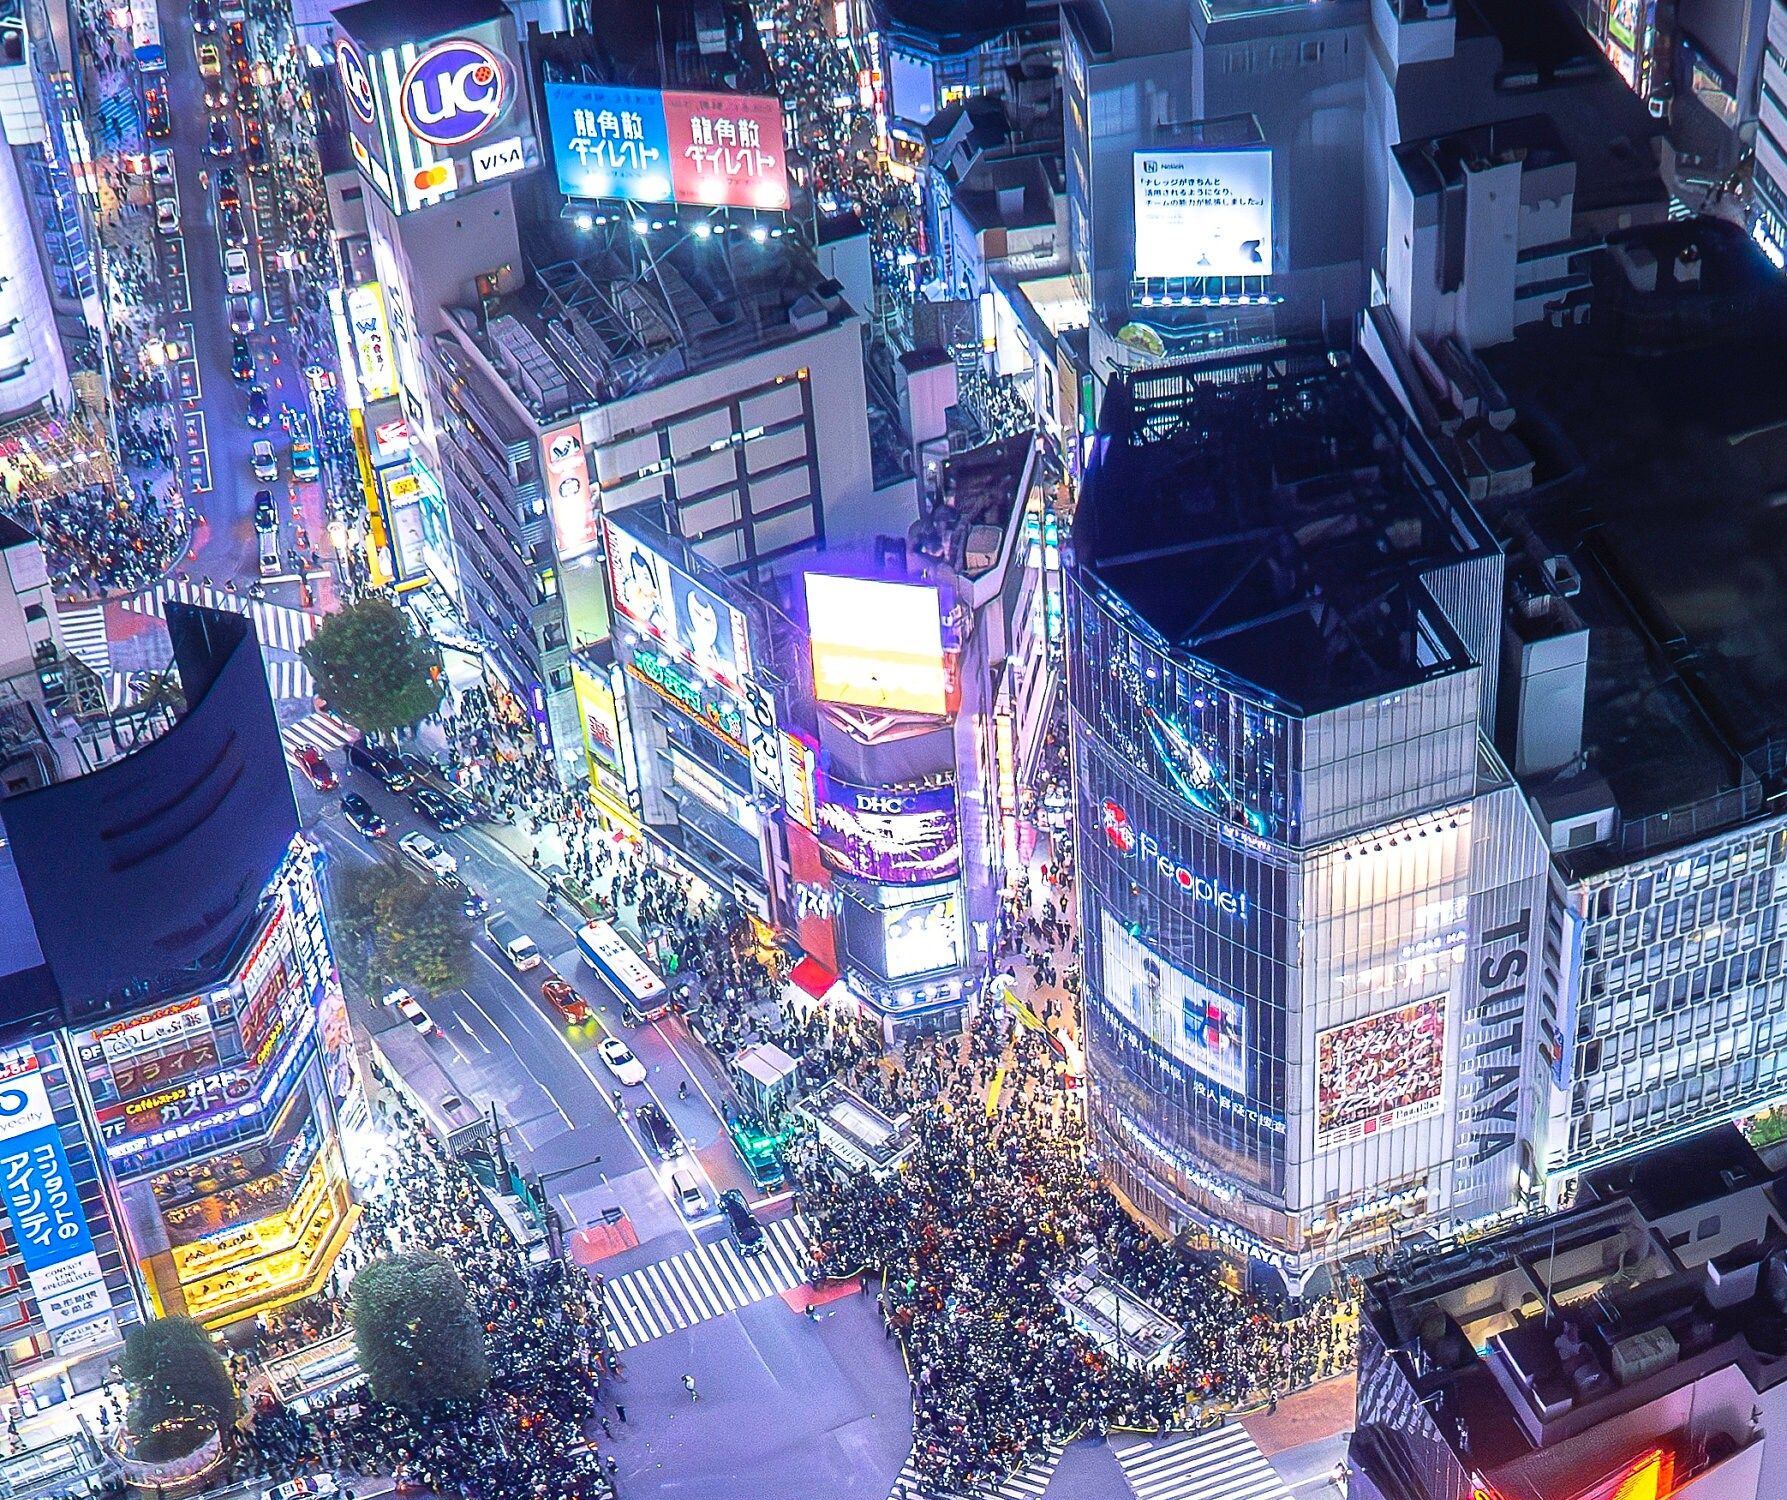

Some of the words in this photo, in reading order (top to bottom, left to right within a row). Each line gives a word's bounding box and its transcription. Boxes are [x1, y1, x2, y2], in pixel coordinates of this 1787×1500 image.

[411, 62, 500, 124] UC
[574, 108, 644, 141] 龍角散
[690, 115, 761, 149] 龍角散
[480, 149, 520, 170] VISA
[568, 137, 659, 170] ダイレクト
[684, 145, 776, 177] ダイレクト
[855, 793, 902, 814] DHC
[78, 1045, 101, 1061] 9F
[1471, 907, 1531, 1167] TSUTAYA
[188, 1070, 238, 1098] ガスト
[0, 1111, 43, 1133] yecity
[160, 1094, 220, 1124] ガスト
[103, 1121, 126, 1139] 7F
[1, 1151, 53, 1246] アイシティ
[34, 1143, 79, 1241] コンタクトの
[1209, 1223, 1283, 1268] TSUTAYA
